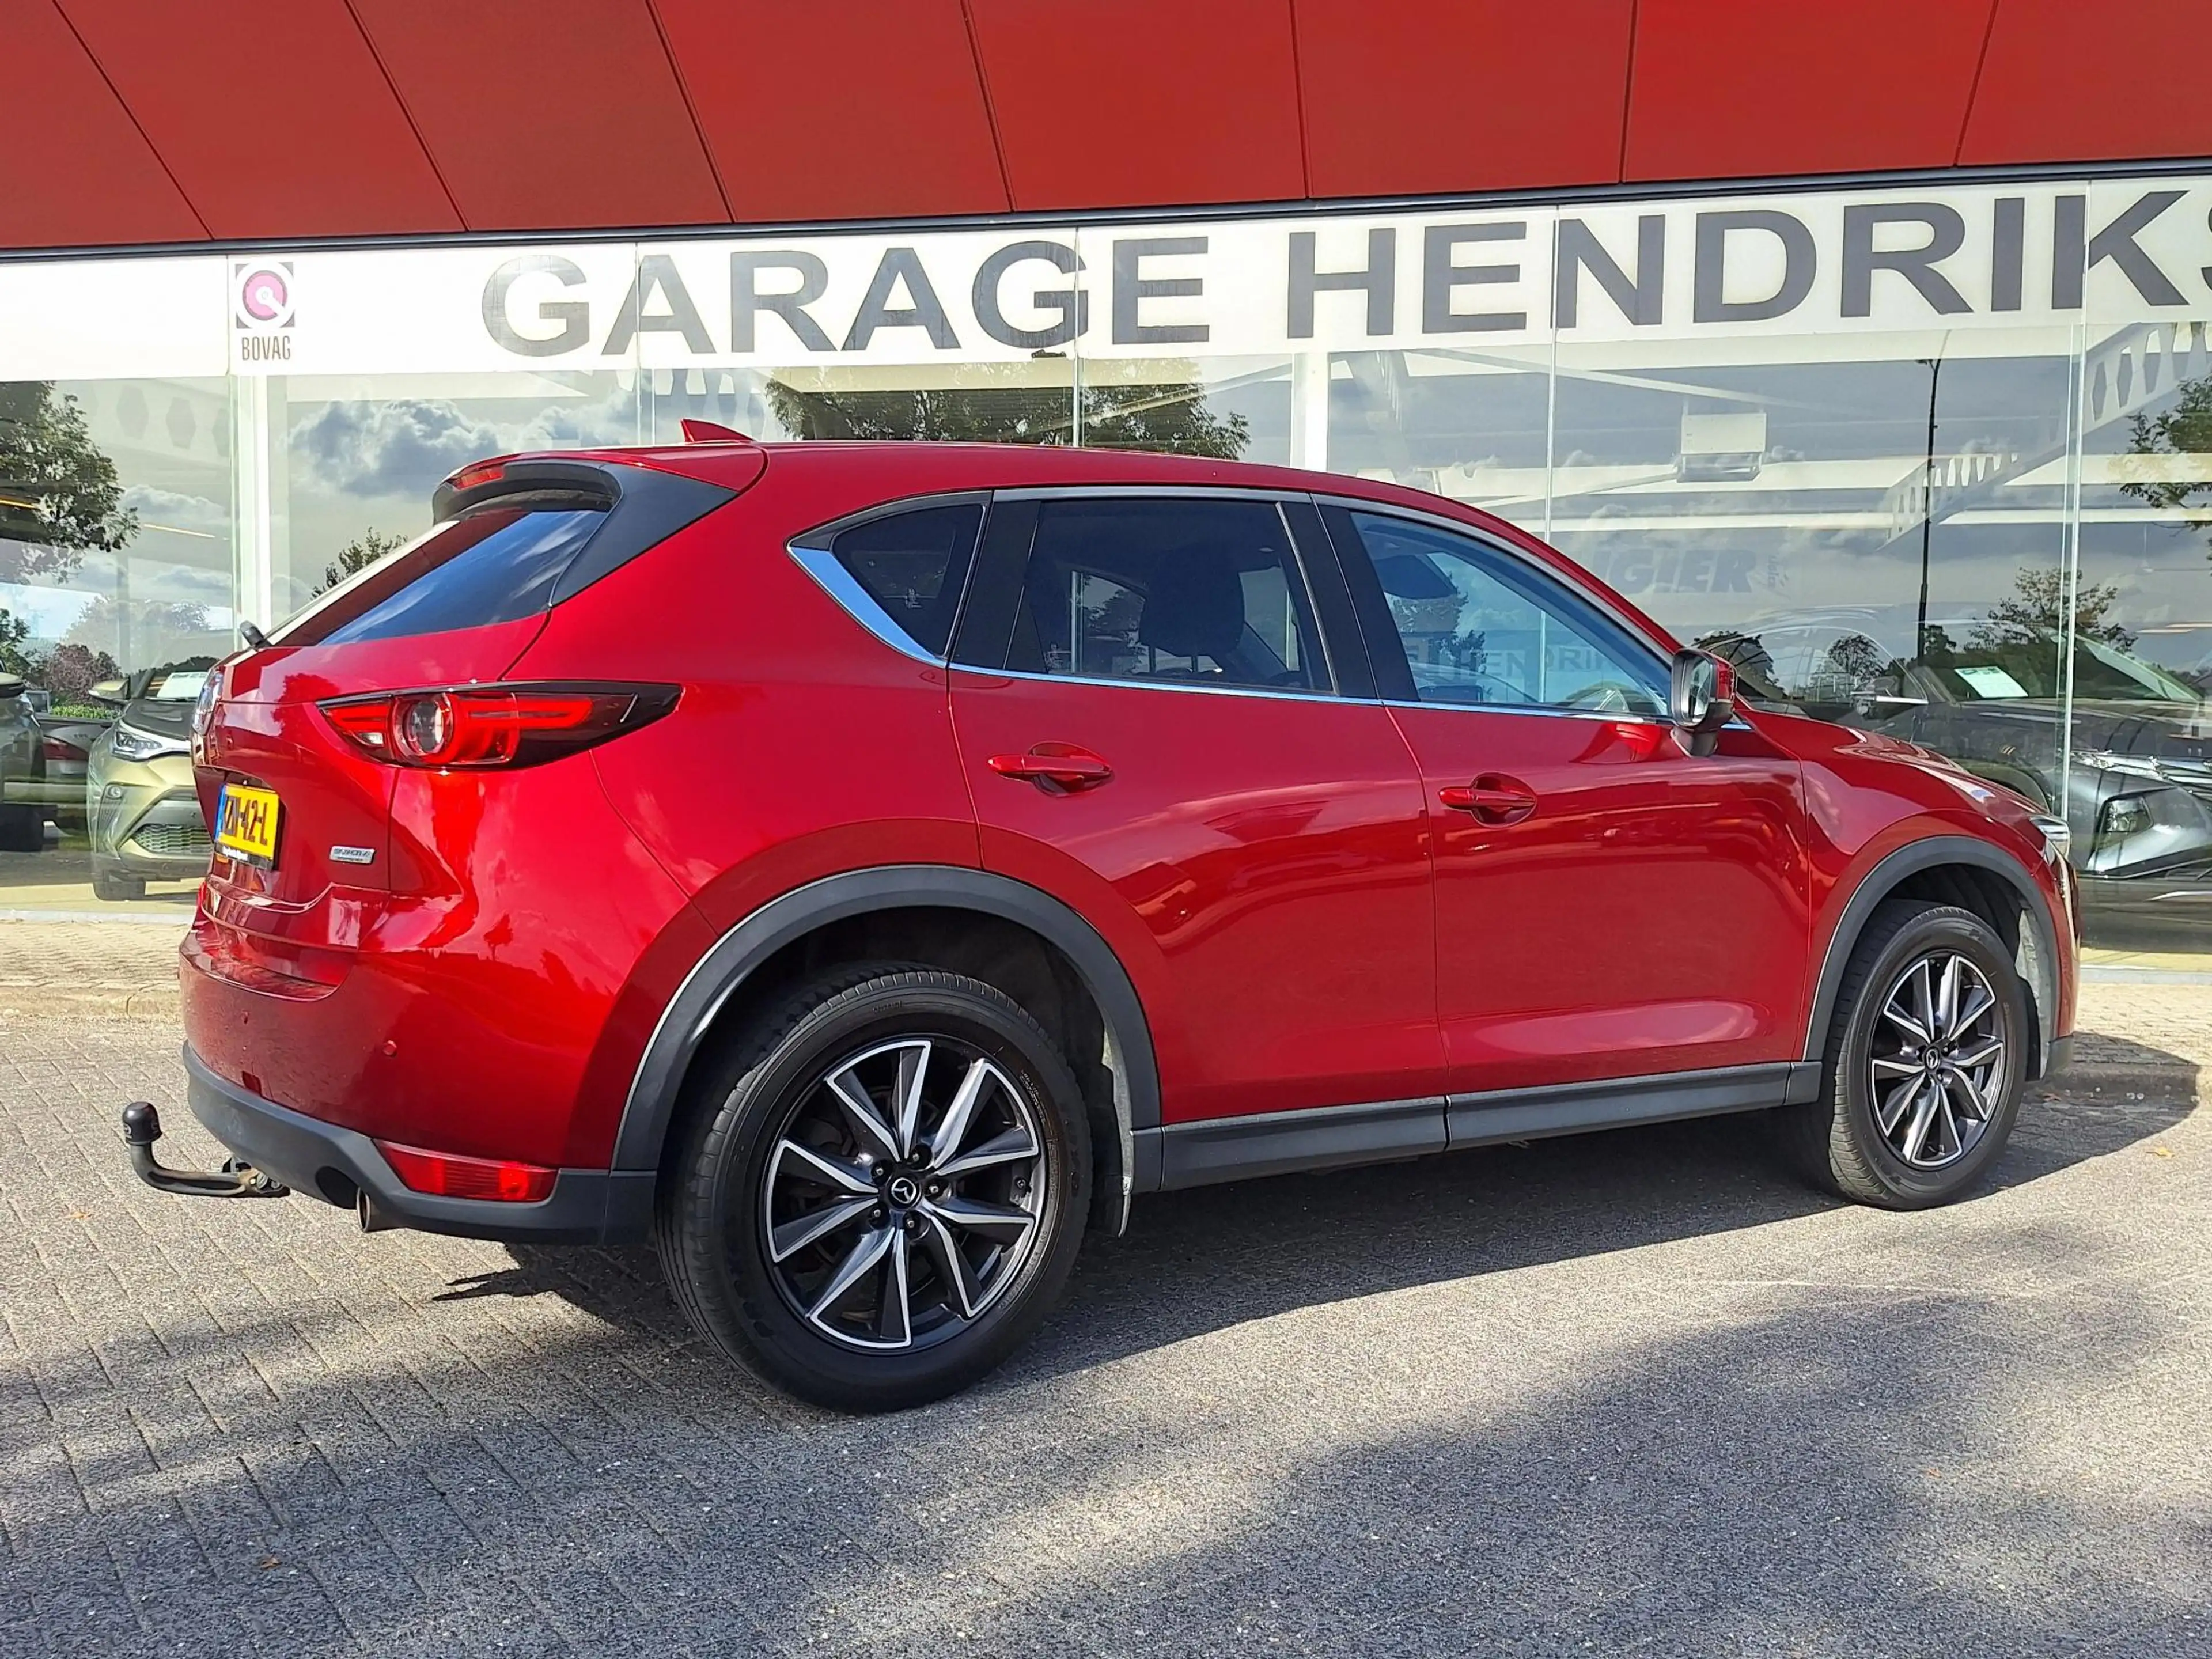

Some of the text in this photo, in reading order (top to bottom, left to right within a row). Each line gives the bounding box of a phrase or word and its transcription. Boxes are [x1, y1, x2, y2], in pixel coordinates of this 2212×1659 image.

[482, 189, 2212, 358] GARAGE HENDRIK
[241, 335, 291, 361] BOVAG
